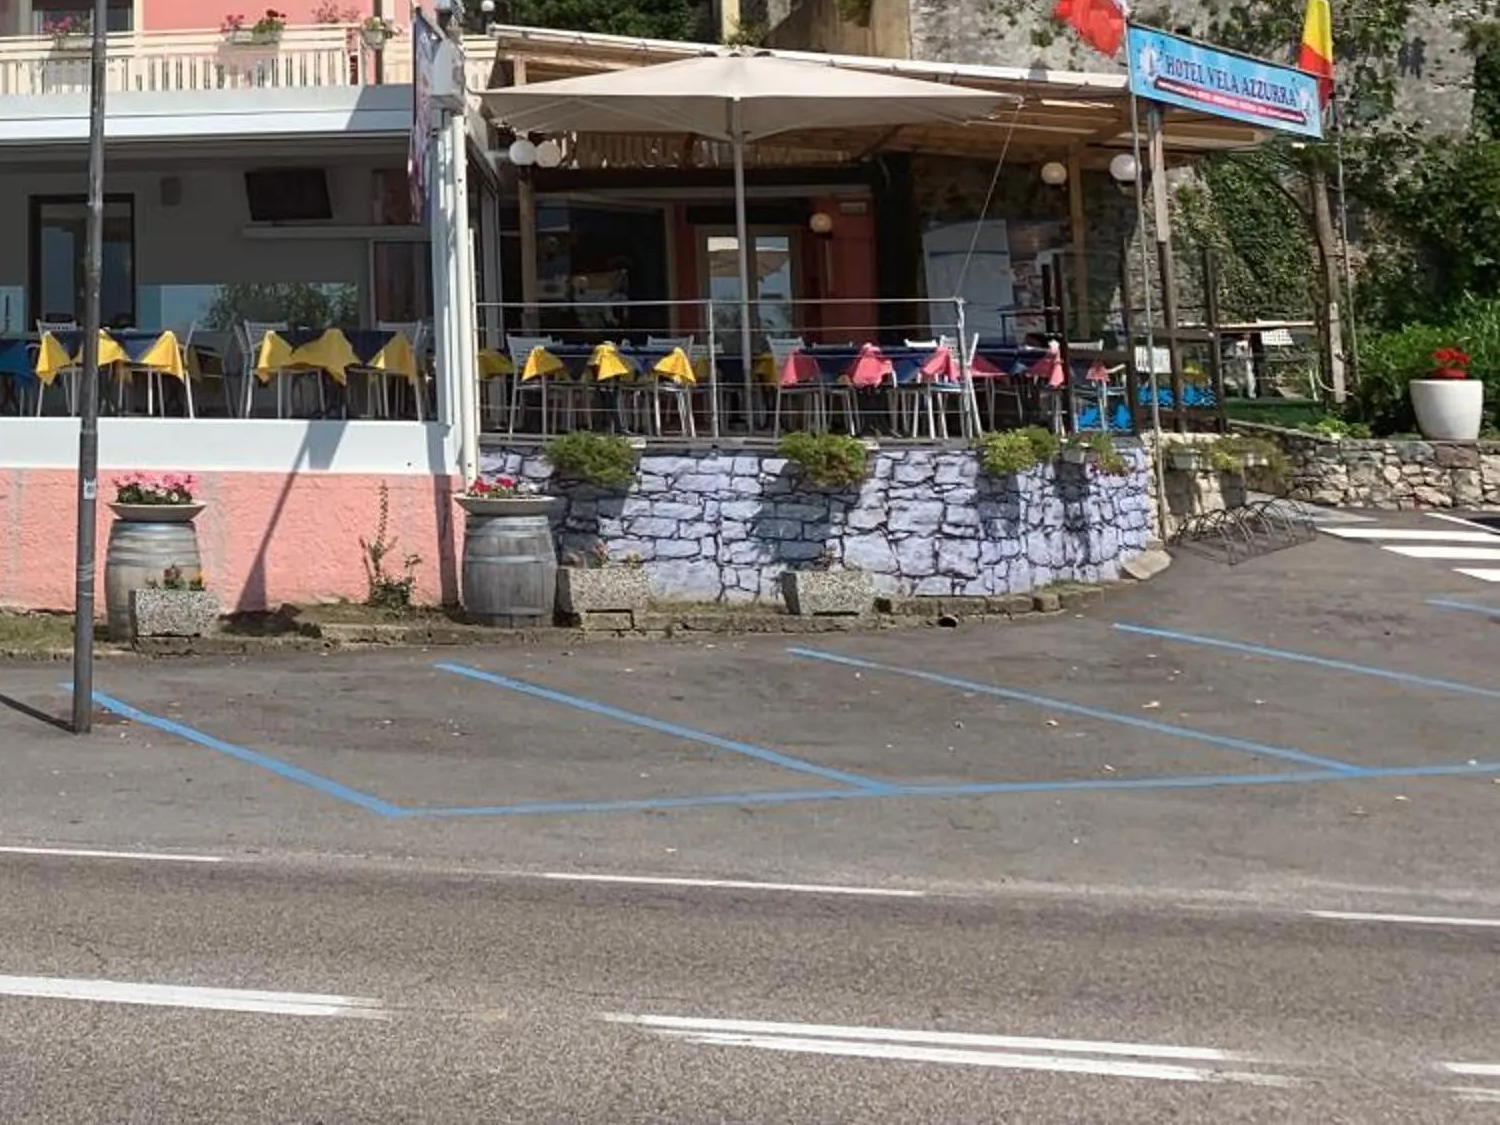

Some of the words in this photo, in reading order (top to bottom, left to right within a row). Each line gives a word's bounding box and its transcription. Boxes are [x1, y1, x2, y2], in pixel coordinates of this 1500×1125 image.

[1165, 53, 1203, 84] HOTEL
[1206, 65, 1240, 93] VELA
[1241, 75, 1297, 108] AZZURRA
